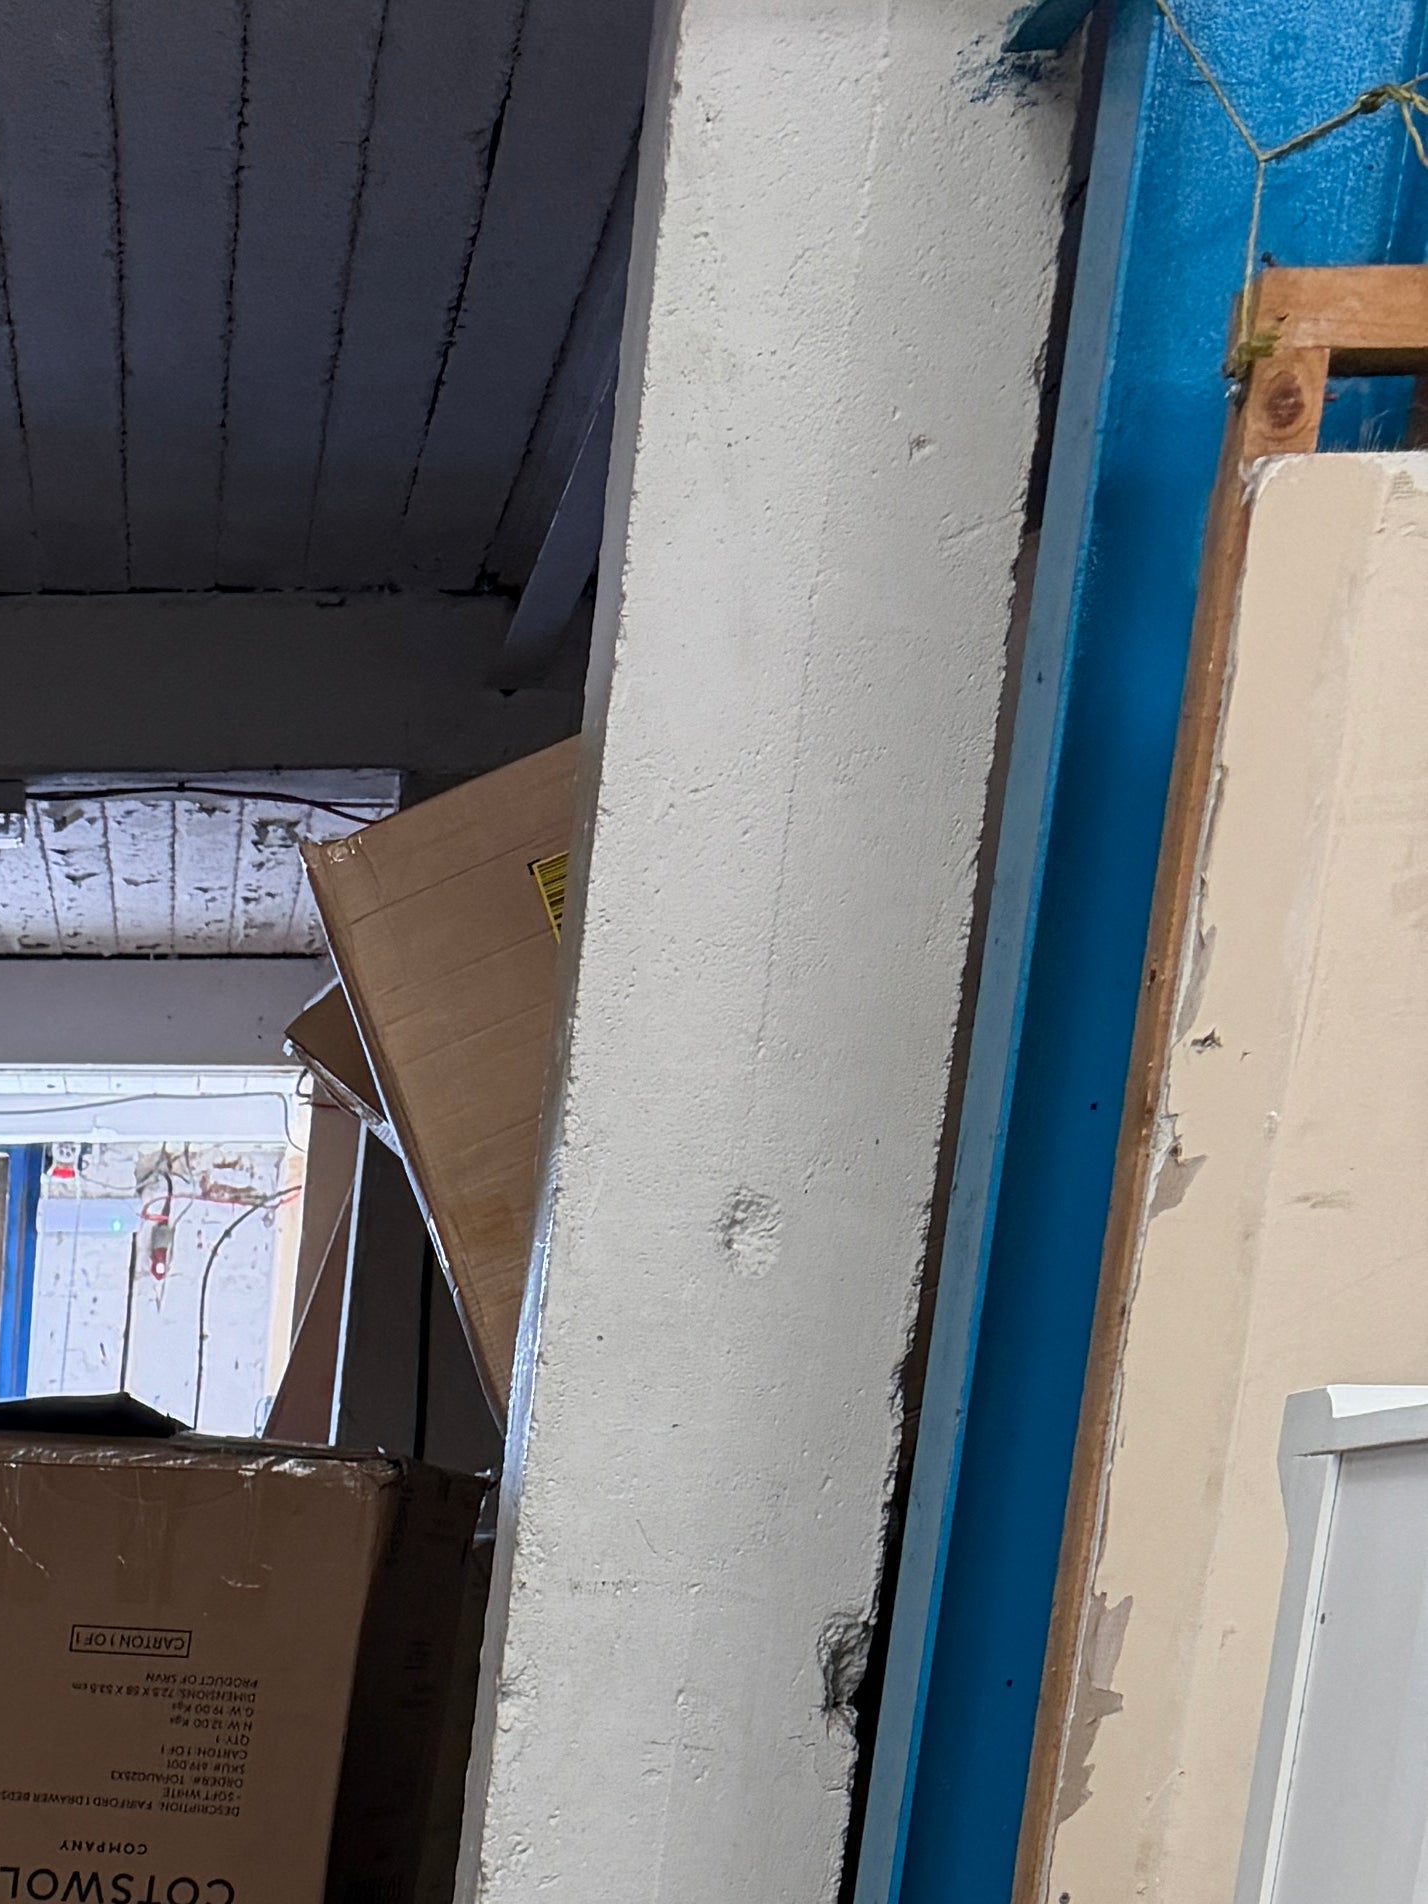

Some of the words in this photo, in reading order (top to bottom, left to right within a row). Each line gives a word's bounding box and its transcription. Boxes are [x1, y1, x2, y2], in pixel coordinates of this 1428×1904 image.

[85, 1633, 106, 1646] OF
[119, 1634, 185, 1650] CARTON
[180, 1674, 197, 1685] OF
[200, 1676, 258, 1688] PRODUCT
[58, 1838, 147, 1855] COMPANY
